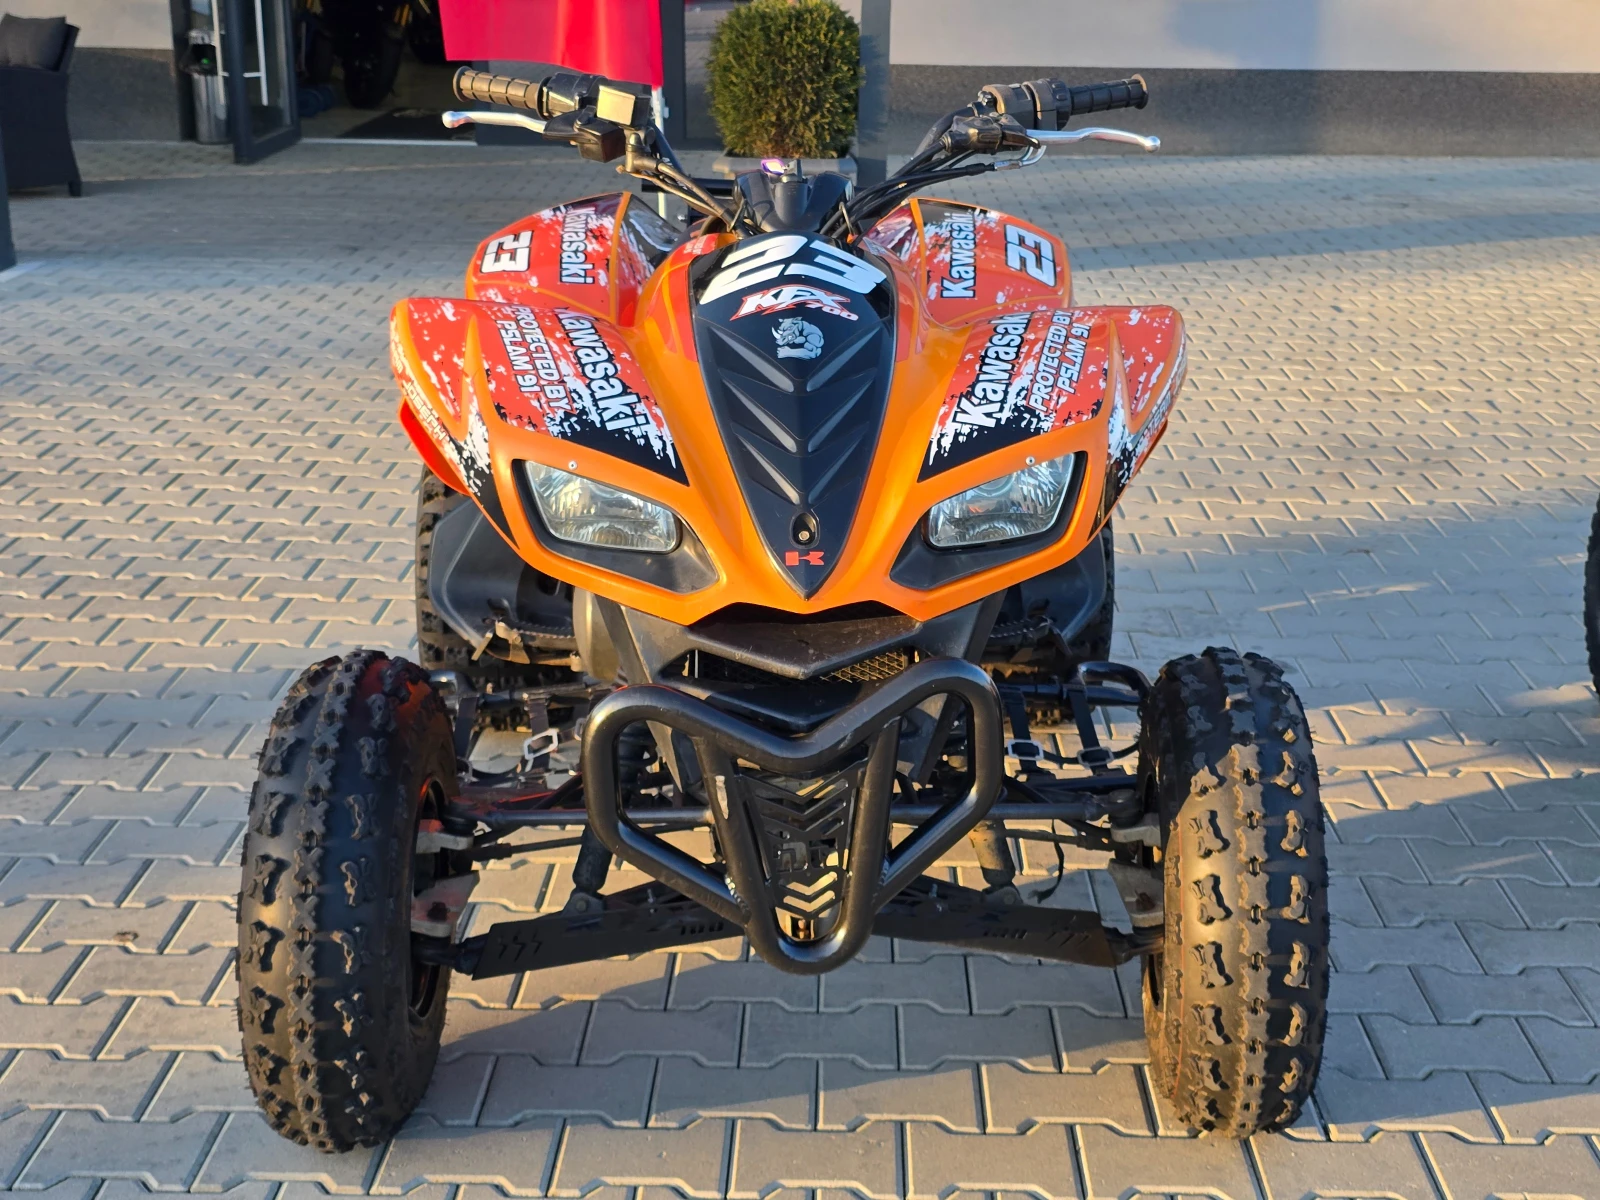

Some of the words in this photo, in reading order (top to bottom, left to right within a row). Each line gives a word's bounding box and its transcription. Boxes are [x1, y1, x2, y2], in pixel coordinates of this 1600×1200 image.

[480, 230, 534, 274] 23
[560, 206, 595, 285] Kawasaki
[699, 235, 888, 306] 23
[940, 212, 976, 299] Kawasaki
[1004, 224, 1057, 287] 23
[729, 284, 851, 322] KFX
[805, 303, 859, 322] 700
[1070, 322, 1091, 340] 91
[496, 319, 528, 372] PSLAM
[515, 374, 542, 393] 91
[514, 305, 564, 383] PROTECTED
[544, 384, 575, 413] BY
[554, 306, 646, 432] Kawasaki
[1026, 323, 1069, 412] PROTECTED
[1051, 309, 1073, 326] BY
[1056, 337, 1087, 395] PSLAM
